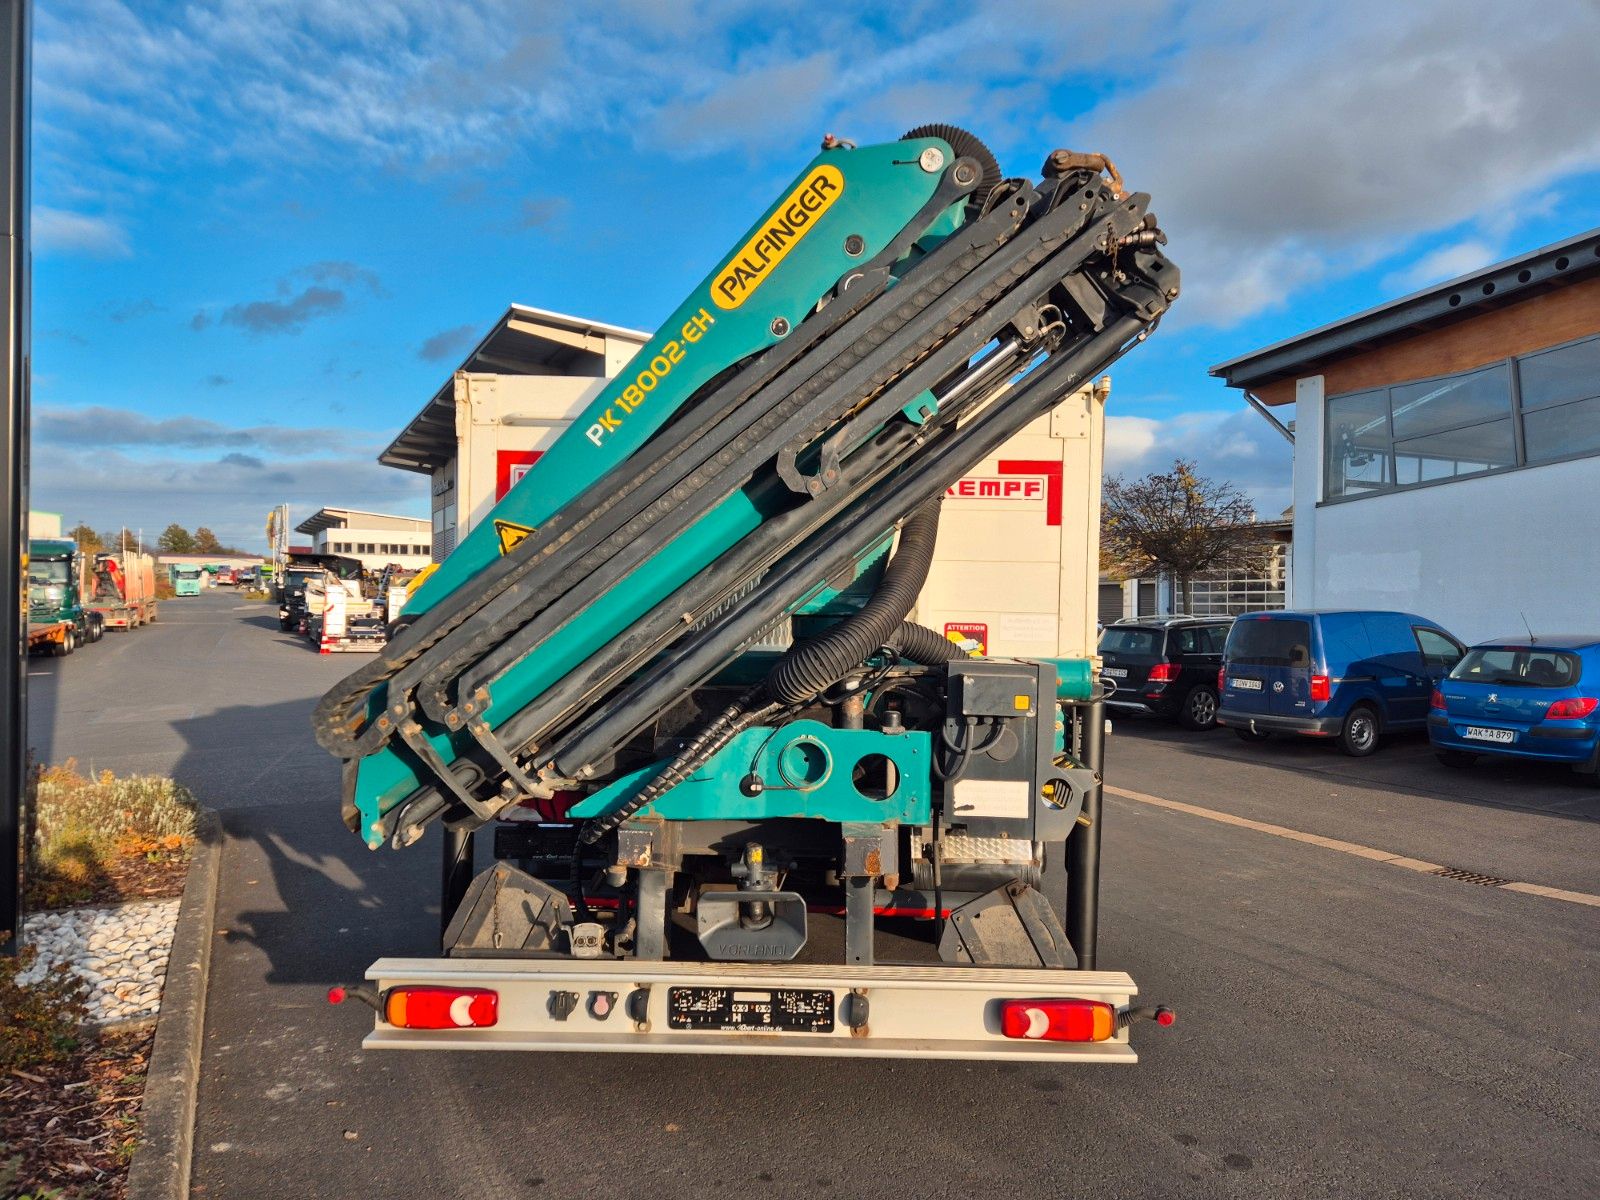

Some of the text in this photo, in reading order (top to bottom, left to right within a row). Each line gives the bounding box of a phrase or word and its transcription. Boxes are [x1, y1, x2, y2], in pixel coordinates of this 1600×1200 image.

[717, 175, 838, 303] PALFINGER
[586, 416, 623, 447] PK
[1467, 727, 1485, 737] WAK
[1496, 731, 1512, 740] 879
[733, 1013, 771, 1023] H S
